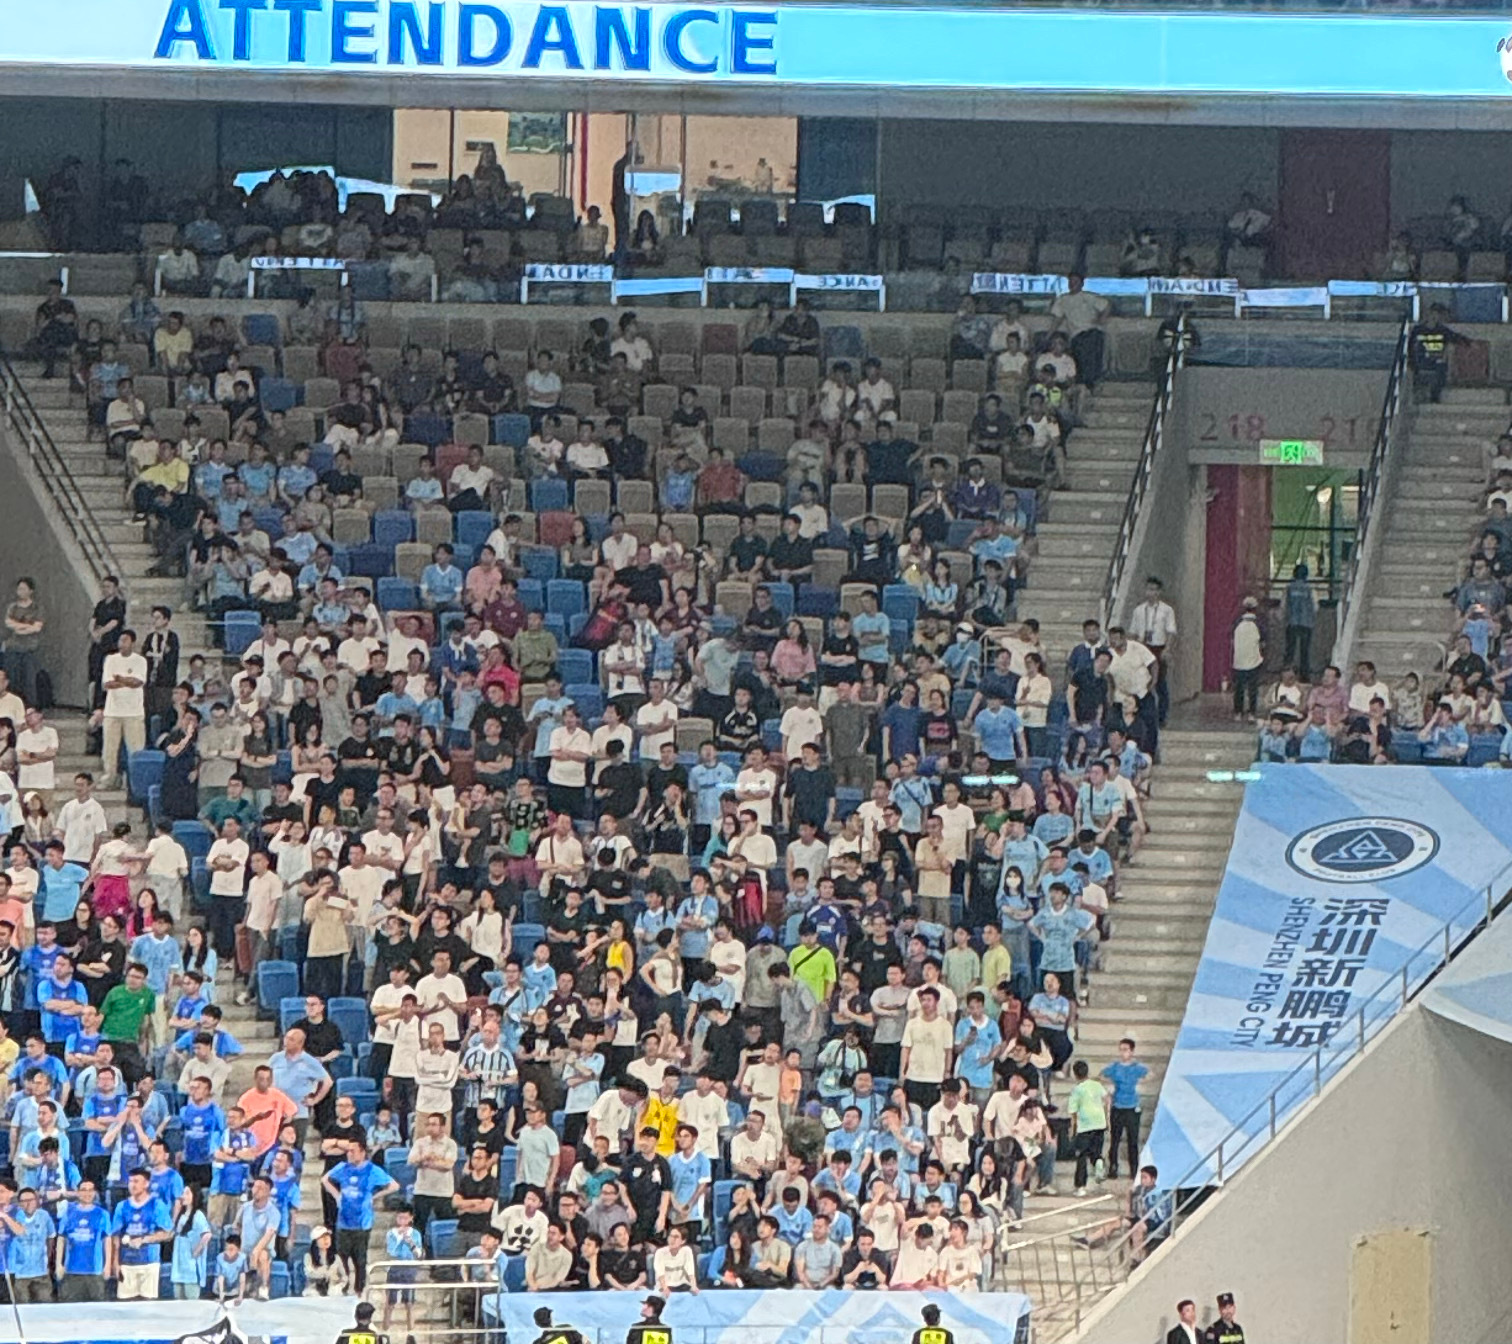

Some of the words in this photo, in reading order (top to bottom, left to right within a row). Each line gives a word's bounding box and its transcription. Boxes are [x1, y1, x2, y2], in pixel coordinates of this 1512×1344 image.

[1200, 413, 1265, 440] 218
[1262, 897, 1316, 969] SHENZHEN
[1245, 972, 1284, 1013] PENG
[1264, 898, 1390, 1049] 深圳新鹏城
[1229, 1017, 1265, 1048] CITY
